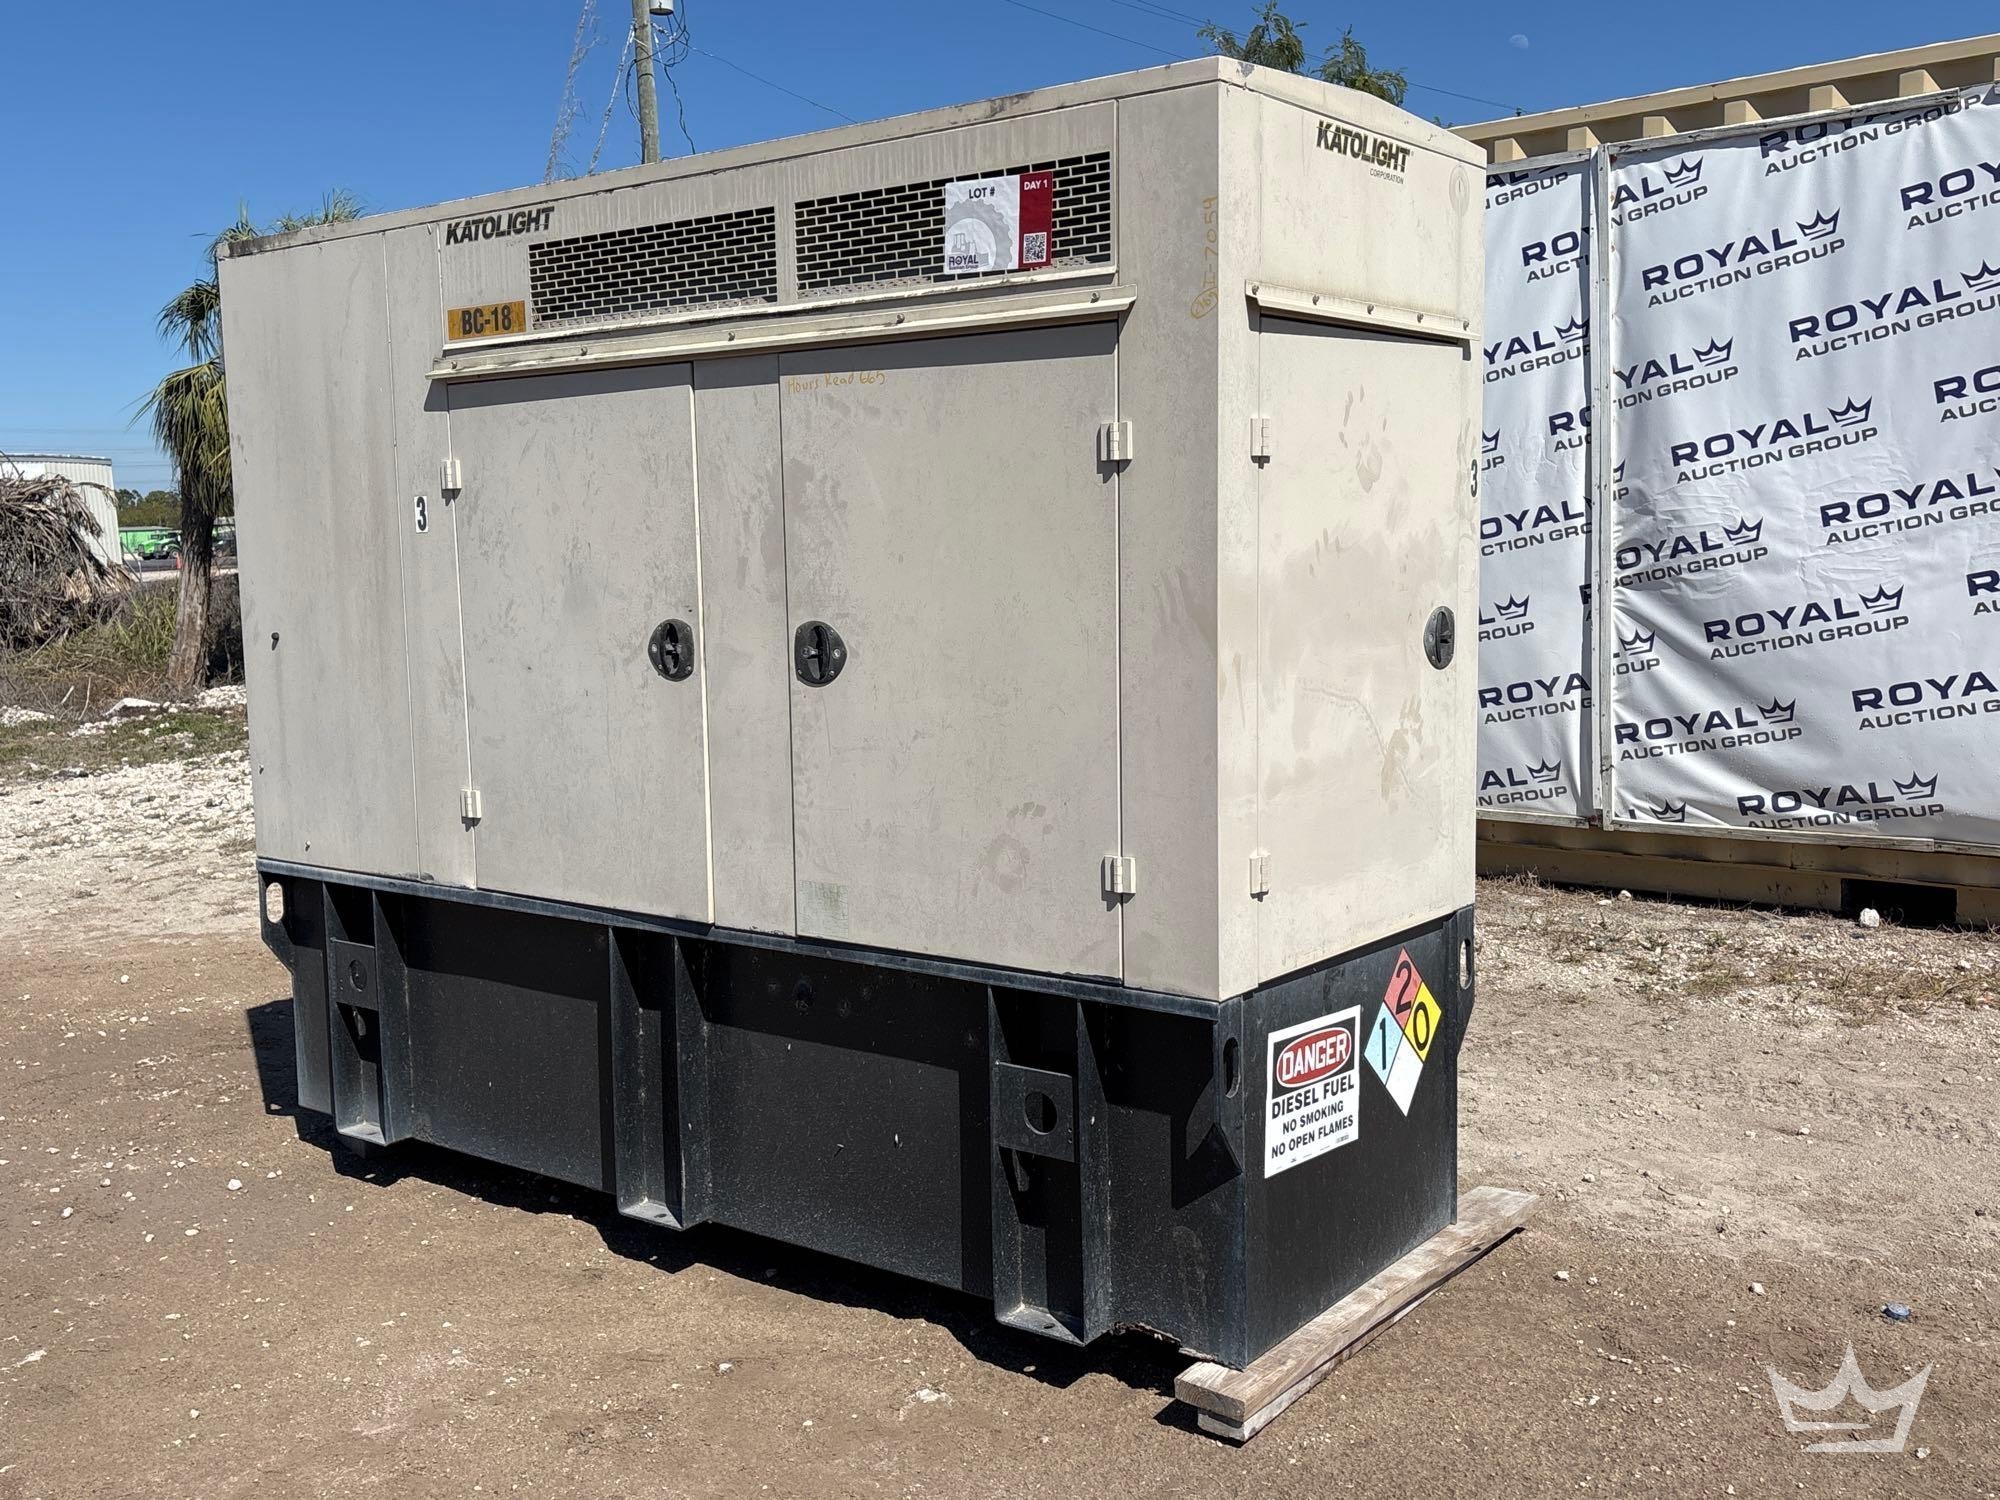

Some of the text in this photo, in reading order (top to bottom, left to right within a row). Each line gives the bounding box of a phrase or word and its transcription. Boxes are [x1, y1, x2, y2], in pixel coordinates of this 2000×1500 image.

[1316, 120, 1410, 173] KATOLIGHT
[1765, 94, 1982, 176] AUCTION GROUP
[969, 187, 995, 199] LOT #
[1024, 179, 1048, 190] DAY 1
[1369, 168, 1404, 184] CORPORATION
[1495, 171, 1568, 206] GROUP
[1628, 186, 1708, 222] GROUP
[446, 206, 554, 245] KATOLIGHT
[949, 254, 979, 266] ROYAL
[1642, 228, 1797, 291] ROYAL
[1648, 238, 1845, 308] AUCTION GROUP
[461, 305, 512, 335] BC-18
[1789, 279, 1961, 343] ROYAL
[1795, 319, 1911, 361] AUCTION
[788, 377, 819, 394] Hours
[1657, 365, 1739, 398] GROUP
[1670, 413, 1829, 467] ROYAL
[1676, 427, 1878, 484] AUCTION GROUP
[1471, 459, 1477, 497] 3
[417, 496, 426, 531] 3
[1820, 473, 1995, 527] ROYAL
[1826, 511, 1943, 546] AUCTION
[1687, 546, 1768, 573] GROUP
[1704, 598, 1859, 642] ROYAL
[1710, 615, 1909, 660] AUCTION GROUP
[1484, 700, 1576, 724] AUCTION
[1614, 708, 1758, 744] ROYAL
[1858, 703, 1977, 730] AUCTION
[1620, 727, 1802, 761] AUCTION GROUP
[1496, 786, 1568, 805] GROUP
[1736, 782, 1895, 816] ROYAL
[1748, 803, 1944, 829] AUCTION GROUP
[1396, 960, 1412, 1016] 2
[1379, 1017, 1387, 1070] 1
[1413, 1001, 1430, 1051] 0
[1282, 1033, 1347, 1081] DANGER
[1272, 1074, 1354, 1119] DIESEL FUEL
[1282, 1100, 1344, 1135] NO SMOKING
[1271, 1114, 1354, 1159] NO OPEN FLAMES
